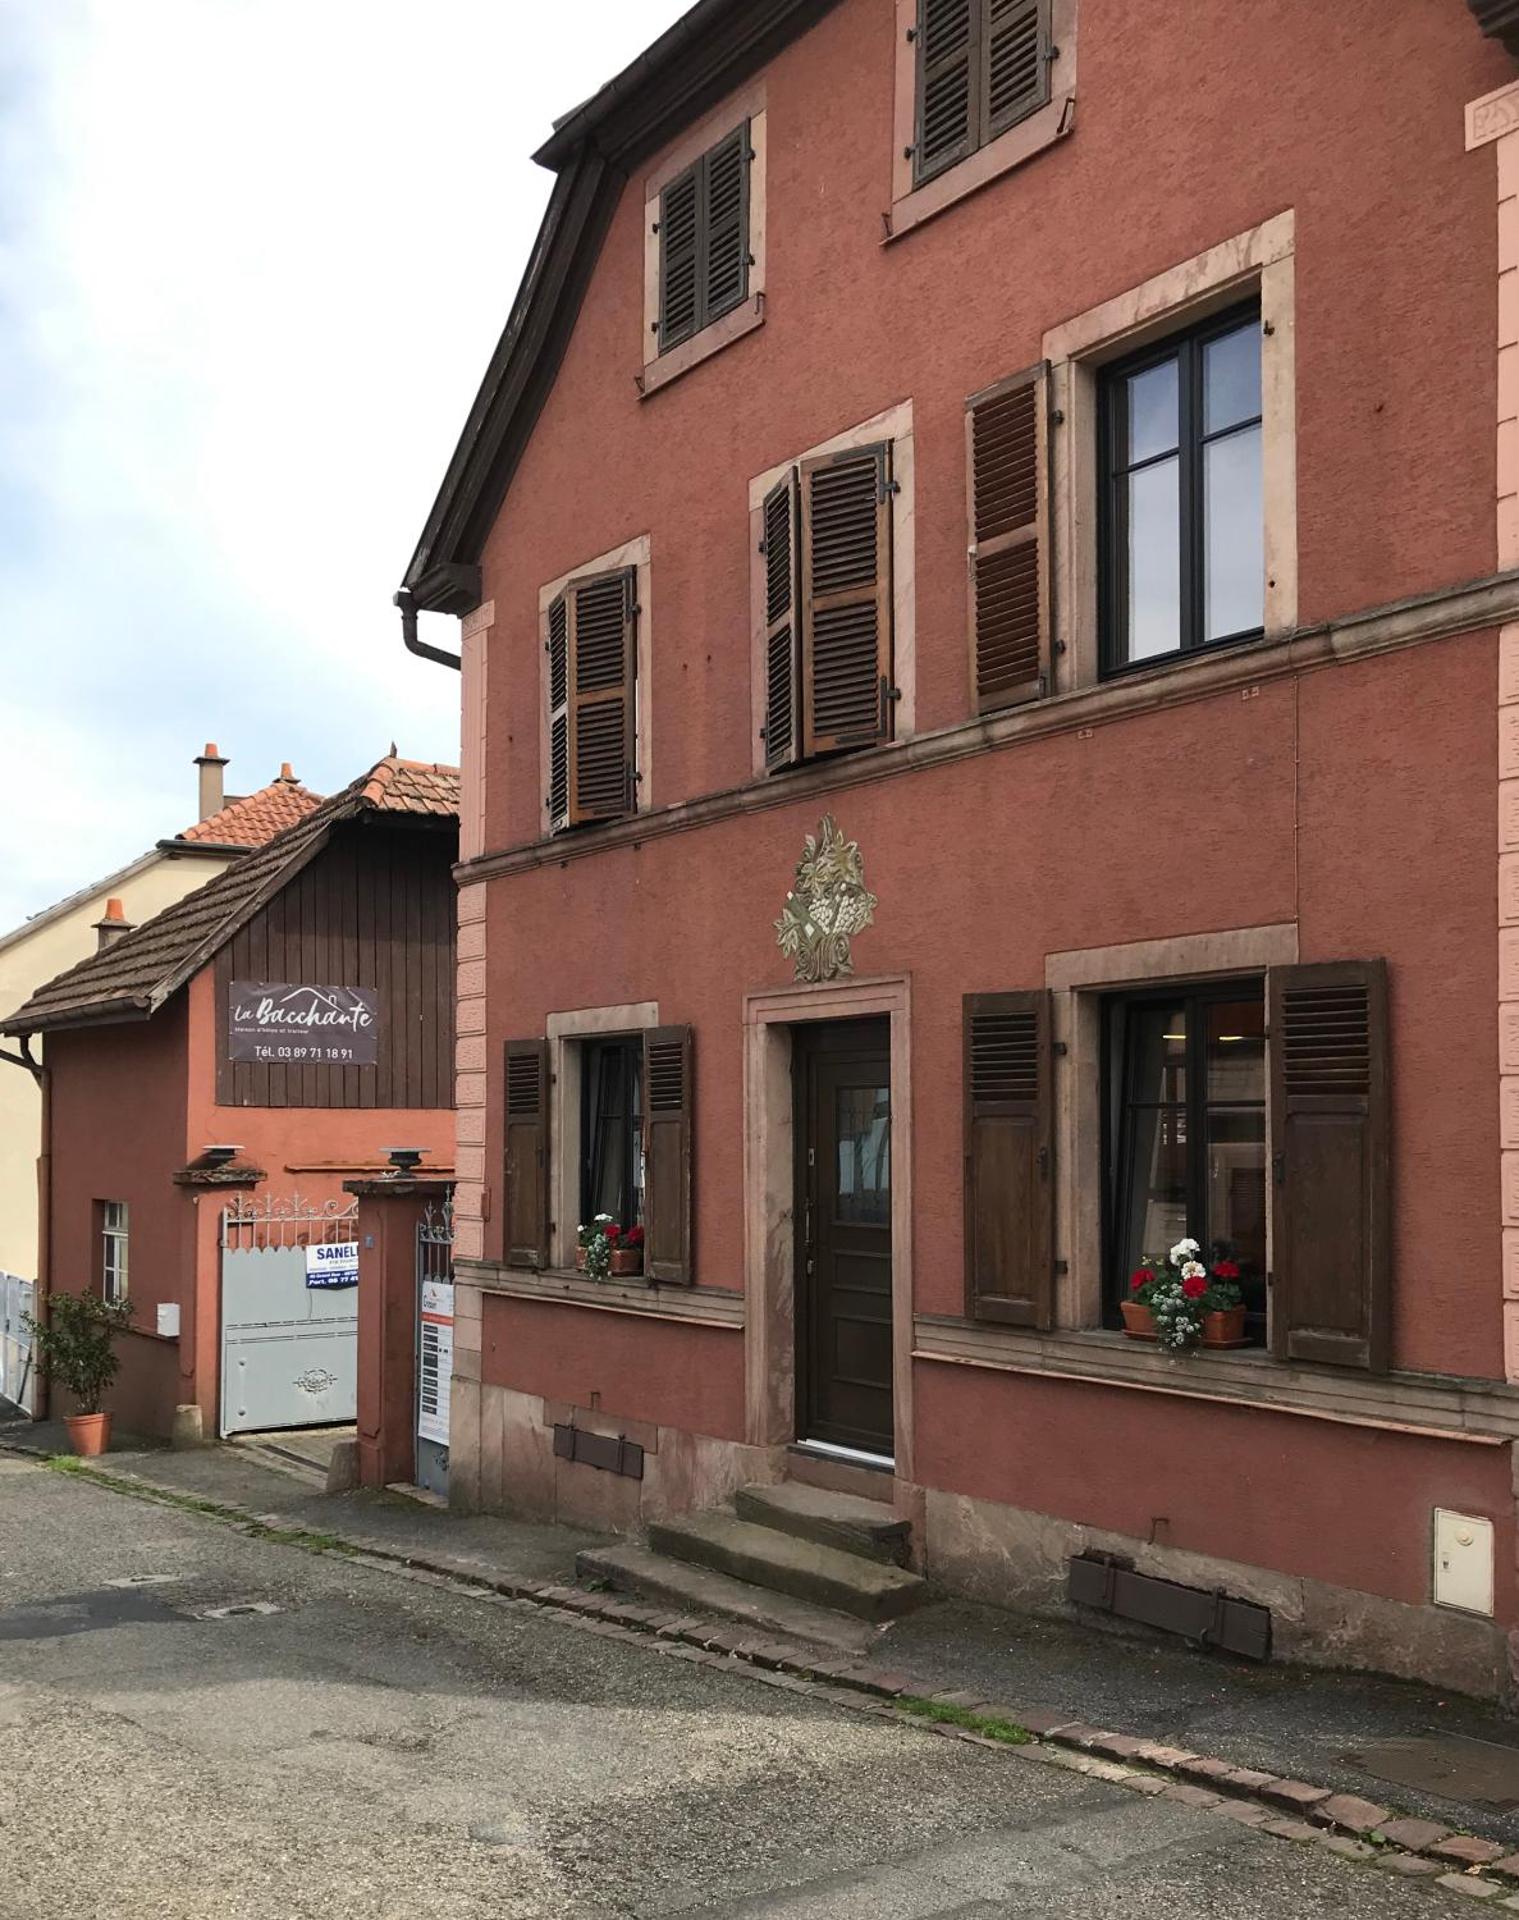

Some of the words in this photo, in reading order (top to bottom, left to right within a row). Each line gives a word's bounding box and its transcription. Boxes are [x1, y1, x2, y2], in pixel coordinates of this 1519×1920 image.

[255, 997, 373, 1032] Bacchante
[254, 1045, 275, 1057] Tél.
[278, 1047, 292, 1057] 03
[294, 1047, 307, 1057] 89
[309, 1048, 322, 1058] 71
[326, 1048, 338, 1059] 18
[341, 1049, 353, 1059] 91
